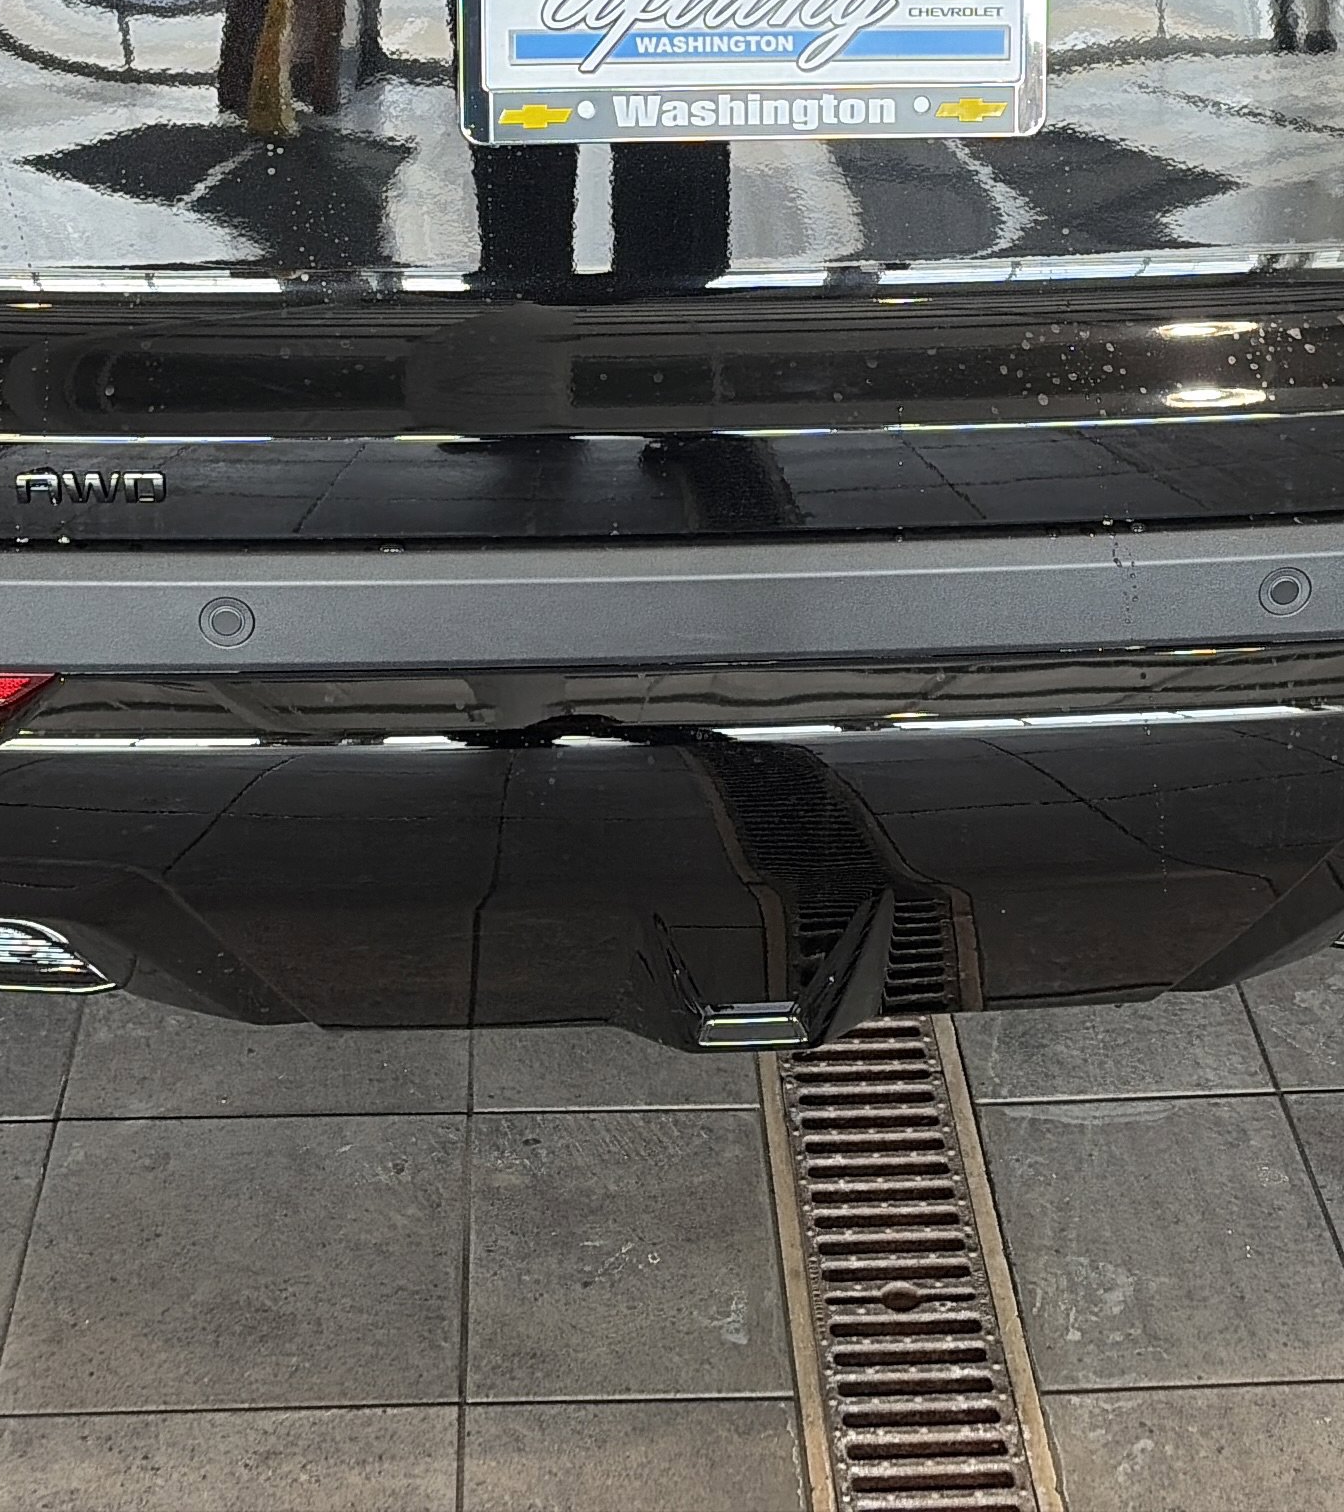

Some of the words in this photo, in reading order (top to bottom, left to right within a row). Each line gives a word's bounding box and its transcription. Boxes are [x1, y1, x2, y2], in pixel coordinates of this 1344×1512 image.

[908, 6, 1004, 18] CHEVROLET
[636, 36, 794, 54] WASHINGTON
[613, 92, 897, 132] Washington
[14, 466, 168, 507] AWD
